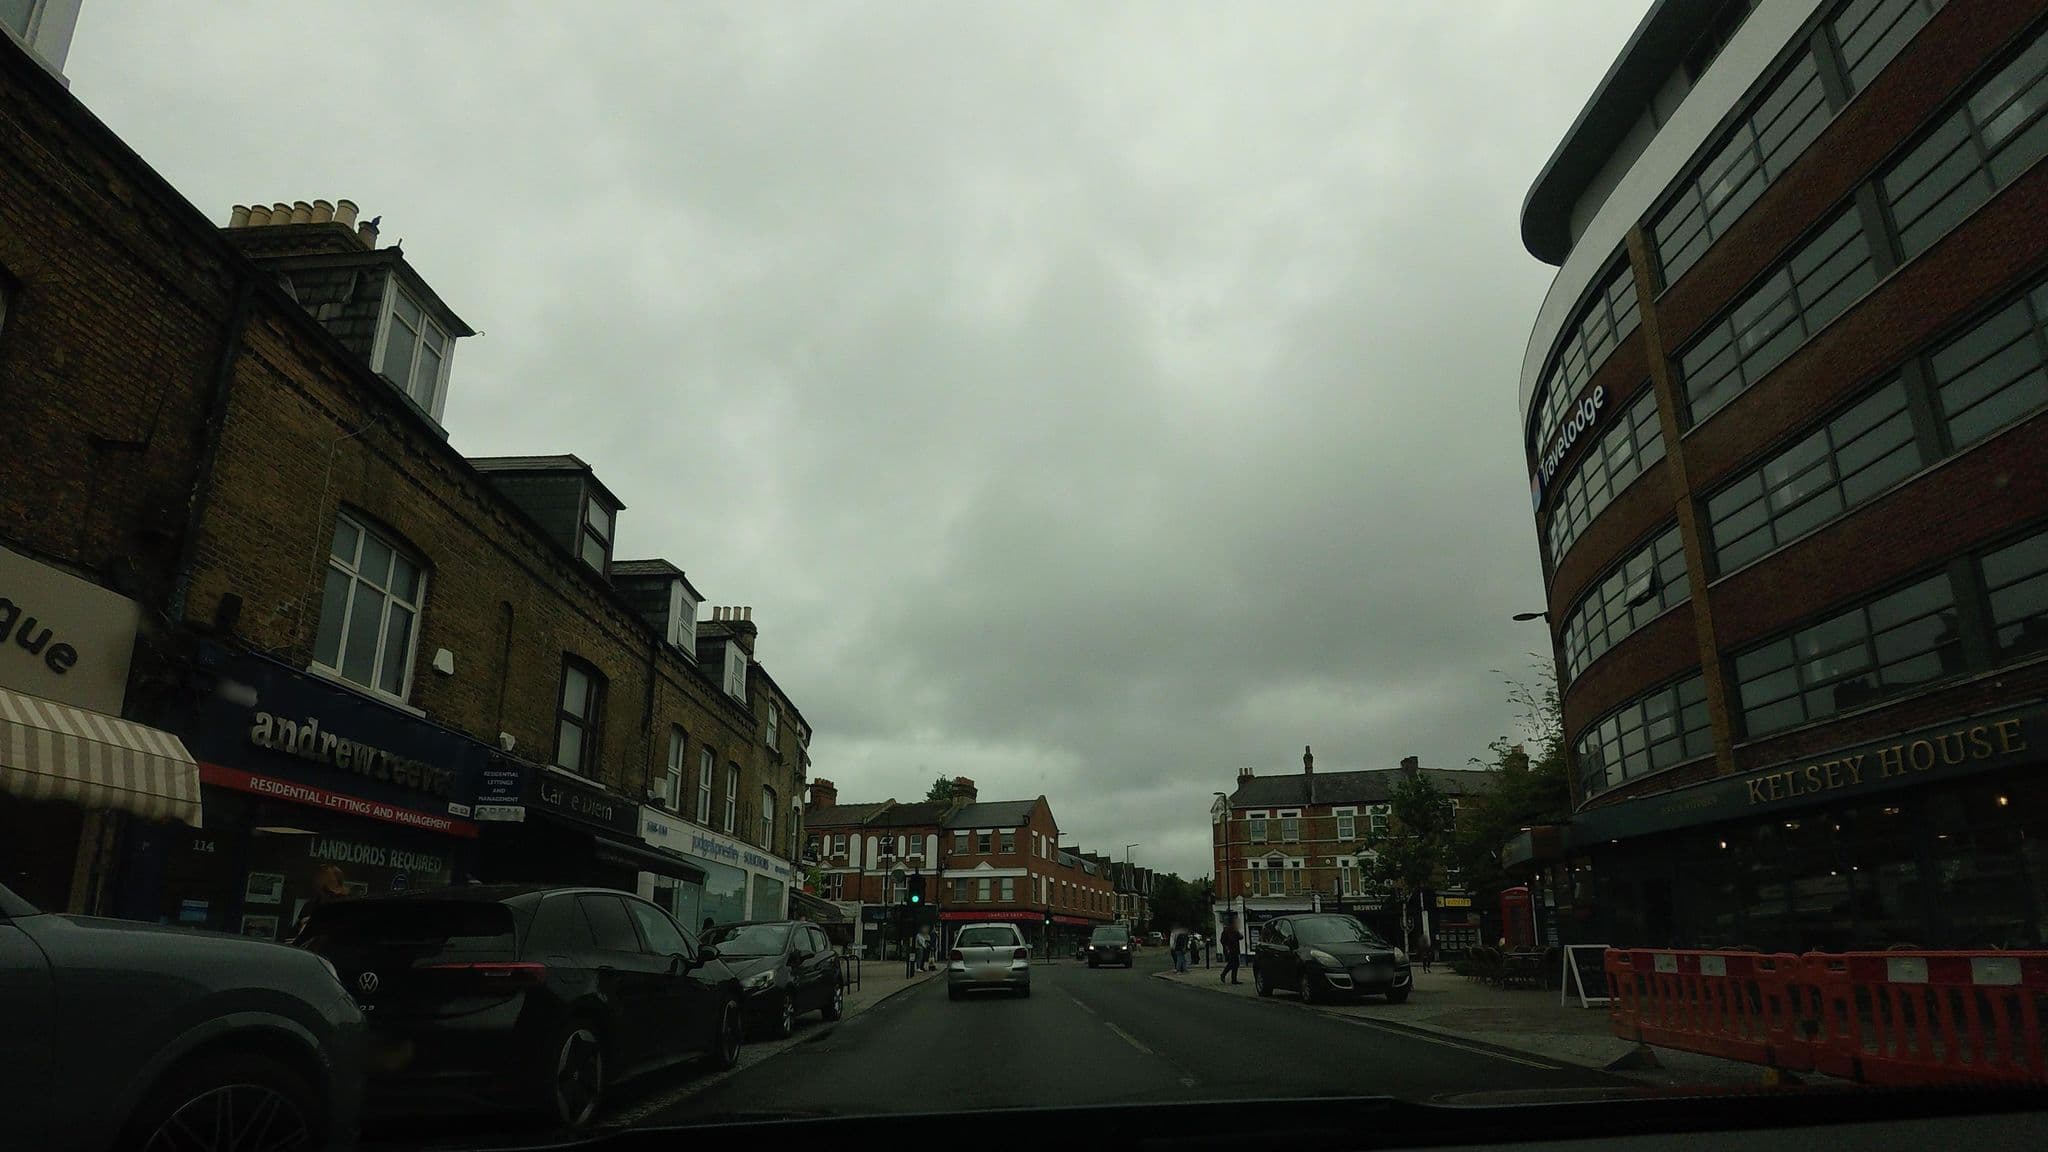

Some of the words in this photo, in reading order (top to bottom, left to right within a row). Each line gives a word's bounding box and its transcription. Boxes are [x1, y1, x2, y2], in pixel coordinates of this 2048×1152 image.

[1540, 384, 1604, 487] Travelodge
[1744, 753, 1866, 806] KELSEY
[1876, 717, 2028, 779] HOUSE
[249, 777, 322, 804] RESIDENTIAL
[324, 794, 371, 814] LETTINGS
[372, 805, 394, 819] AND
[395, 810, 452, 831] MANAGEMENT
[192, 839, 215, 852] 114
[309, 836, 386, 866] LANDLORDS
[389, 849, 442, 873] REQUIRED
